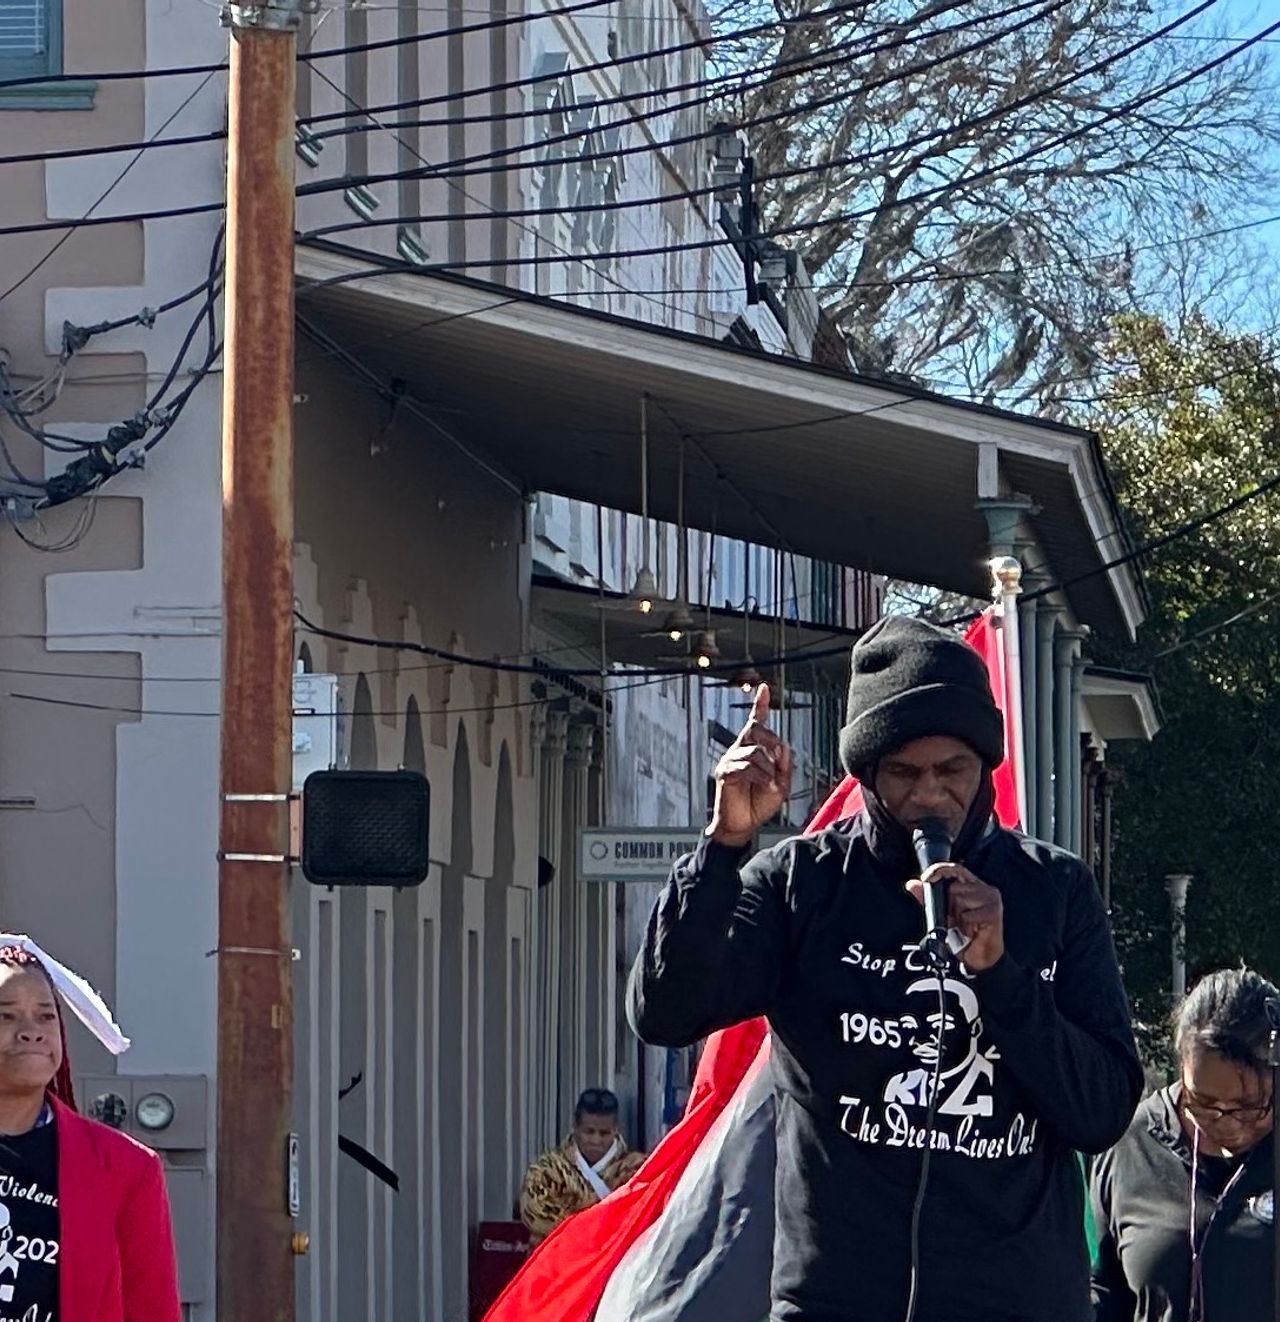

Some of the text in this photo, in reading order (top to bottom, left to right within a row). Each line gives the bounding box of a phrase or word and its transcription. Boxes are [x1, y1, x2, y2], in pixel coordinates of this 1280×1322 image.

[614, 841, 697, 859] COMMON POW
[840, 943, 897, 977] Stop
[839, 1013, 902, 1048] 1965
[839, 1095, 880, 1144] The
[954, 1114, 1004, 1159] Lives
[13, 1235, 60, 1264] 202
